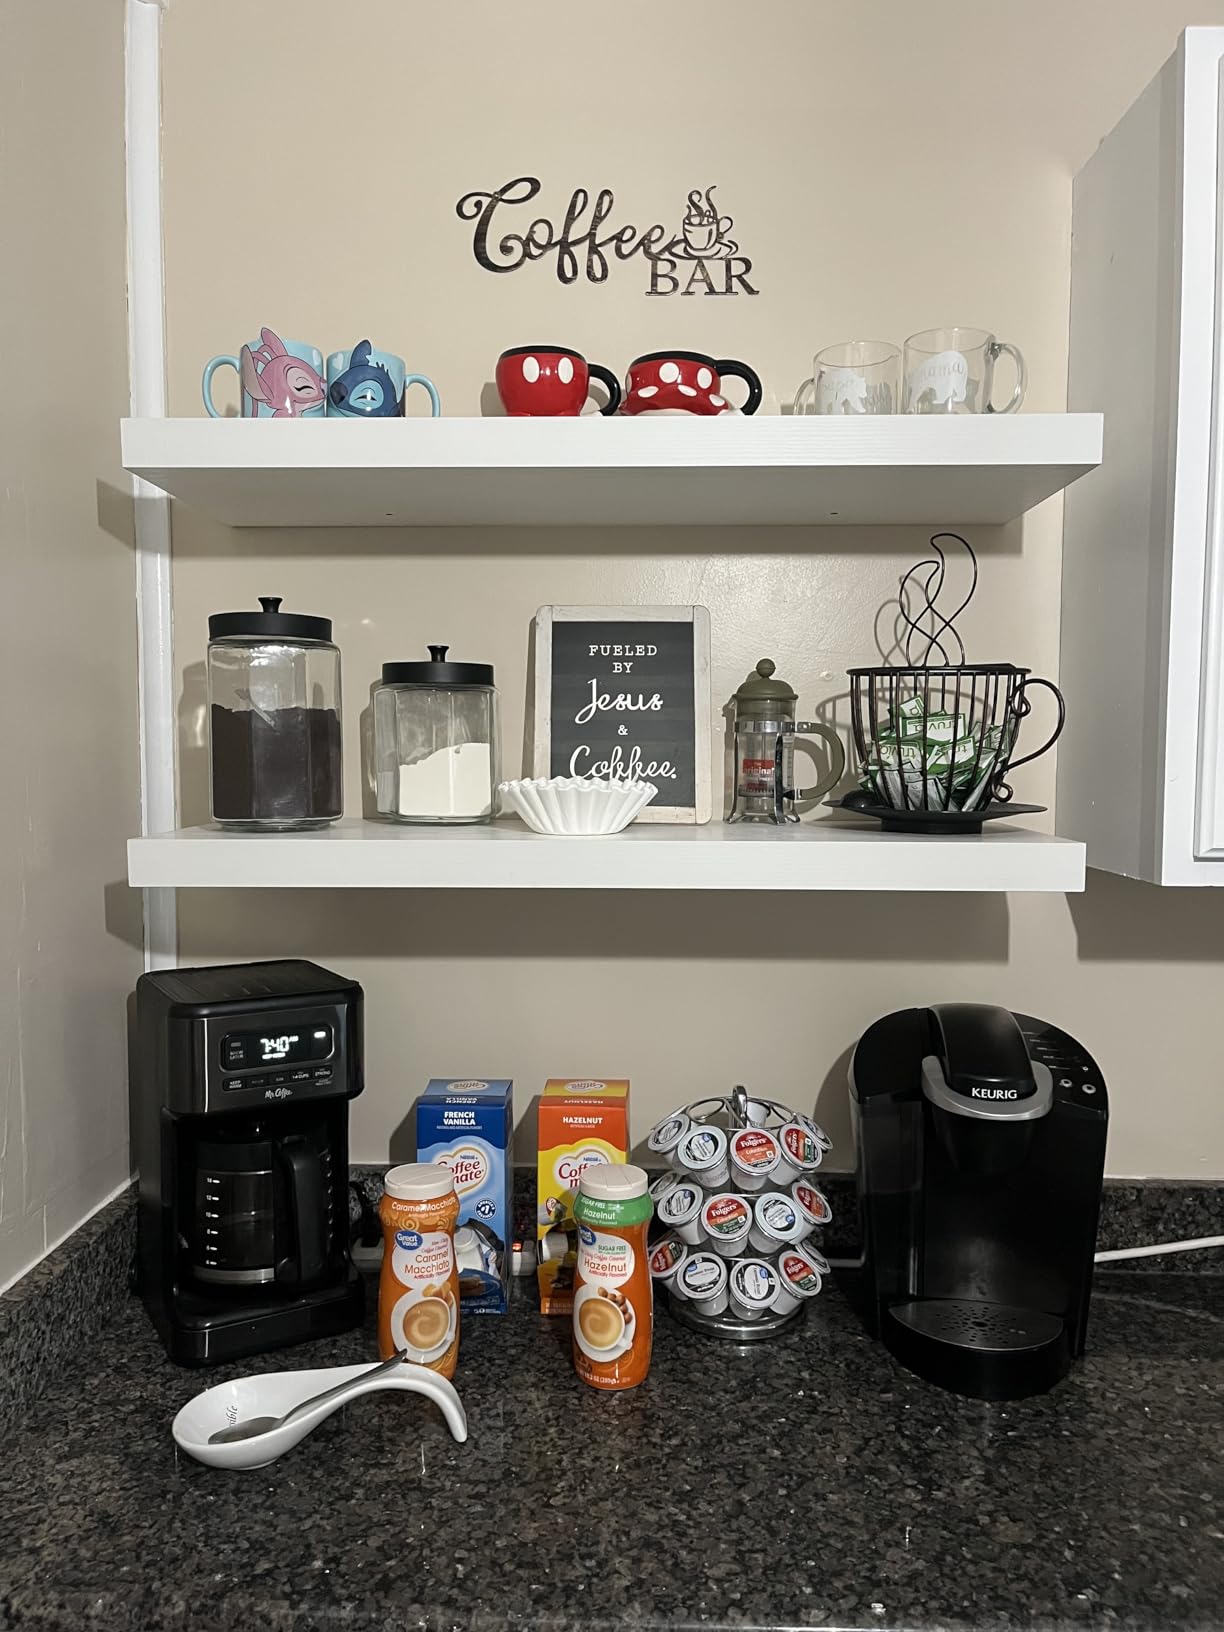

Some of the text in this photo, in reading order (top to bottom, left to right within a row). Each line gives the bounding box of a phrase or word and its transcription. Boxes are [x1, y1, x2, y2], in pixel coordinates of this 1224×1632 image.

[456, 177, 686, 285] Coffee
[645, 256, 760, 296] BAR
[588, 644, 658, 656] FUELED
[612, 662, 633, 673] BY
[574, 678, 664, 724] Jesus
[617, 724, 629, 736] &
[971, 1087, 1018, 1100] KEURIG
[443, 1118, 476, 1126] VANILLA
[740, 1137, 768, 1148] Folgers
[583, 1207, 616, 1220] Hazelnut
[711, 1203, 737, 1217] Folgers
[396, 1233, 418, 1242] Great
[415, 1249, 449, 1264] Caramel
[404, 1260, 450, 1275] Macchiato
[584, 1257, 627, 1272] Hazelnut
